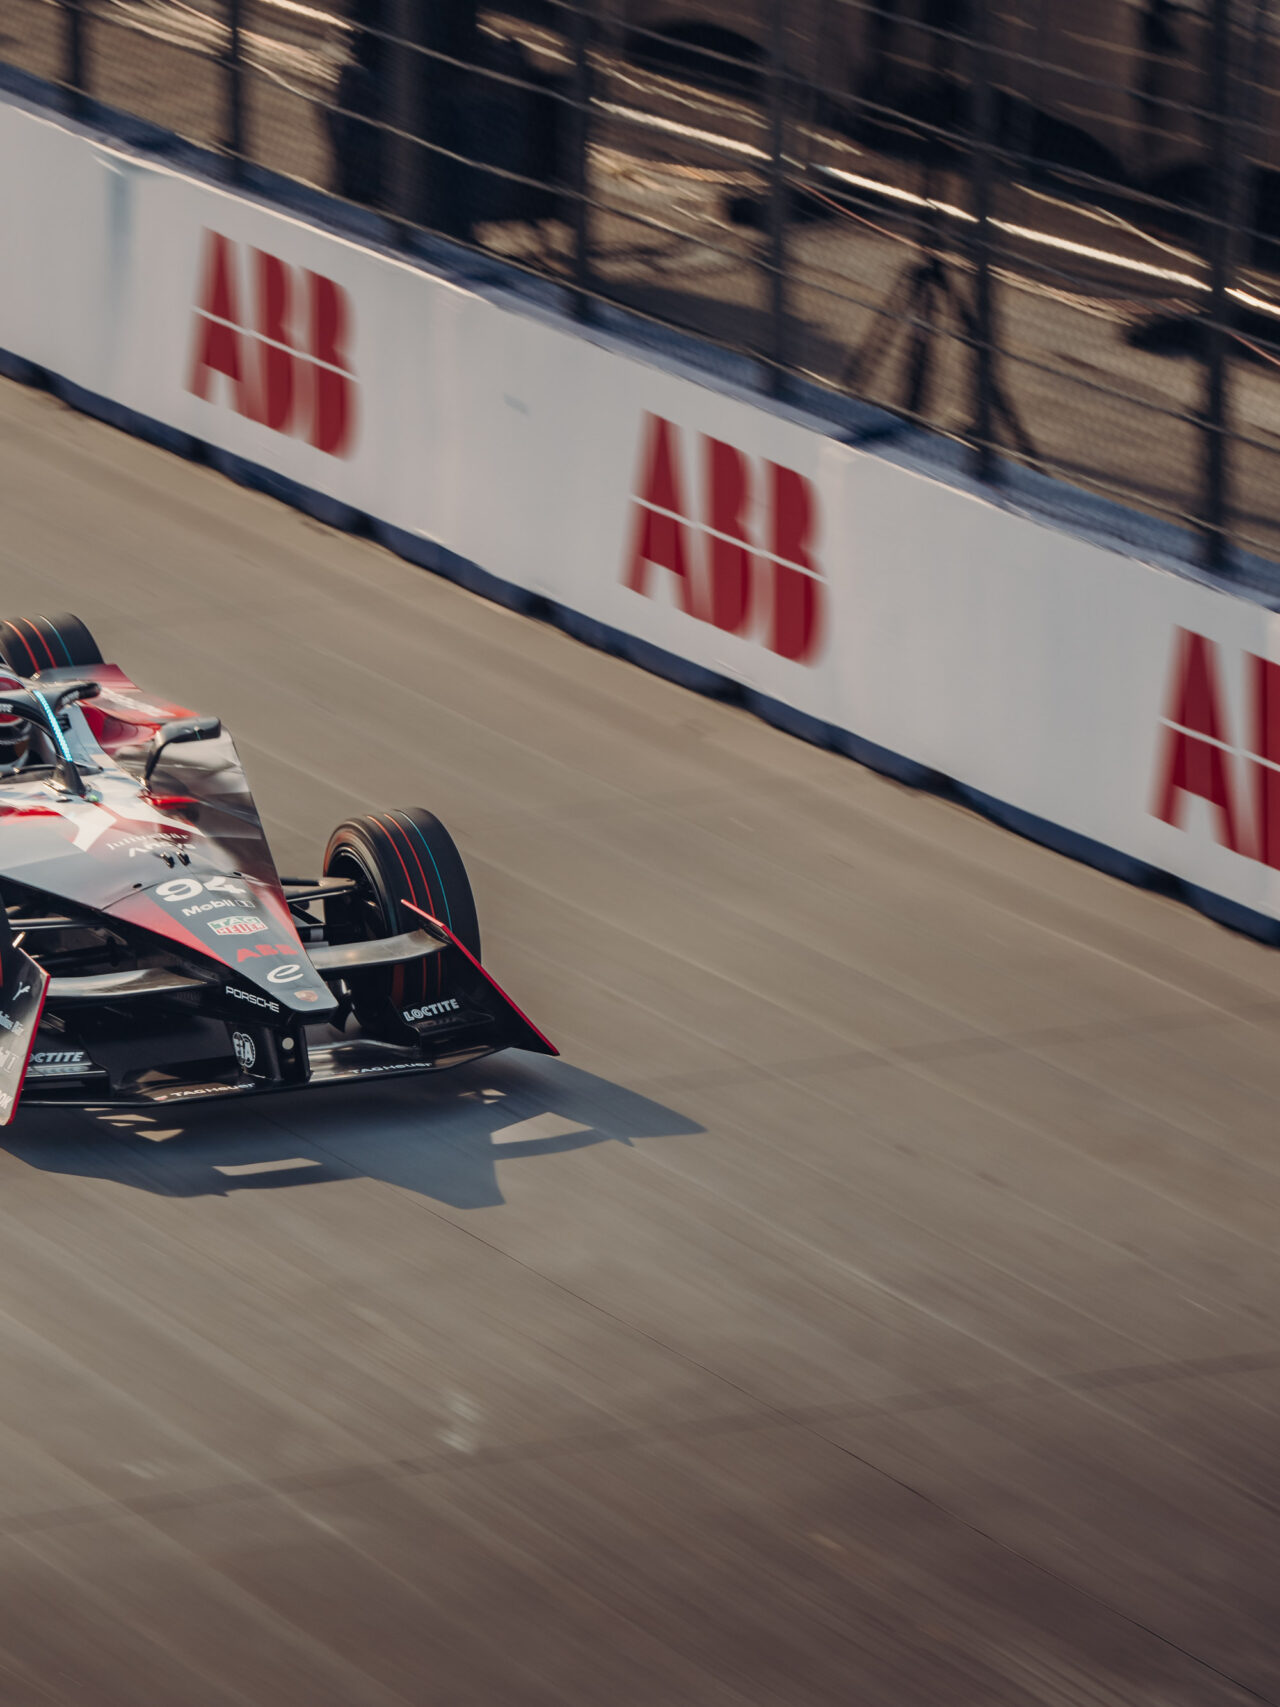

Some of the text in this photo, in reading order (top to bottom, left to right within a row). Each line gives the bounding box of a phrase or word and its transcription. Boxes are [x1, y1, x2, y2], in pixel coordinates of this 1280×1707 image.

[185, 226, 360, 461] ABB
[618, 410, 830, 668] ABB
[155, 876, 247, 902] 94
[181, 899, 236, 917] Mobil
[237, 944, 299, 963] ABB
[225, 986, 280, 1013] PORSCHE
[403, 998, 460, 1022] LOCTITE
